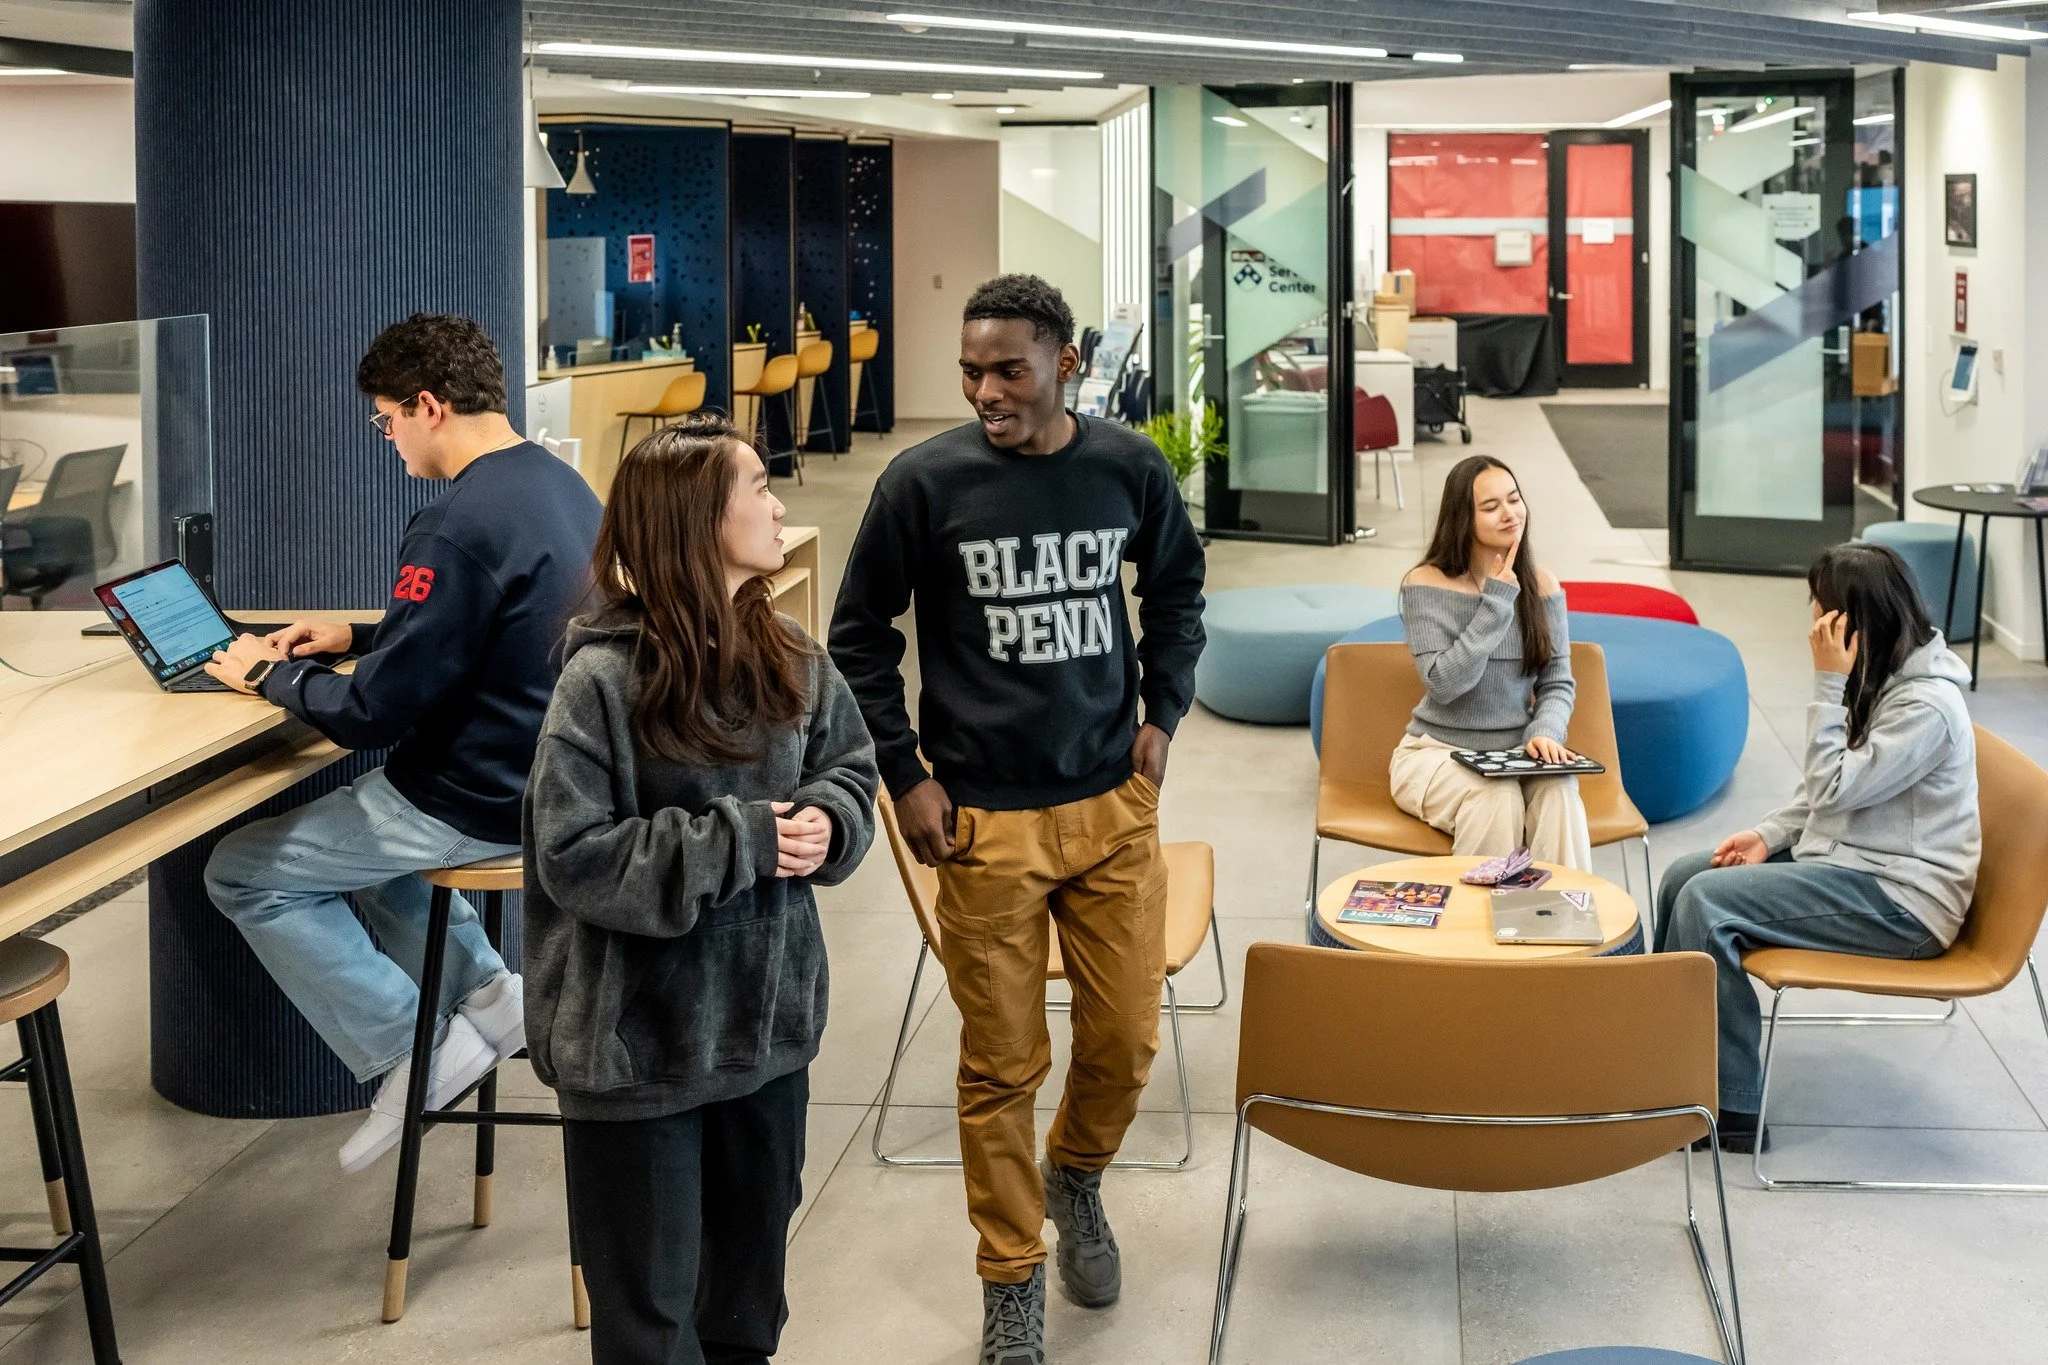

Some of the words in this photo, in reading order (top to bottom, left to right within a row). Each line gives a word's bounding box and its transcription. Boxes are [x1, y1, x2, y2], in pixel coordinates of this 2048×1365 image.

[1268, 281, 1316, 293] Center
[393, 564, 435, 602] 26
[958, 528, 1128, 598] BLACK
[984, 593, 1113, 664] PENN
